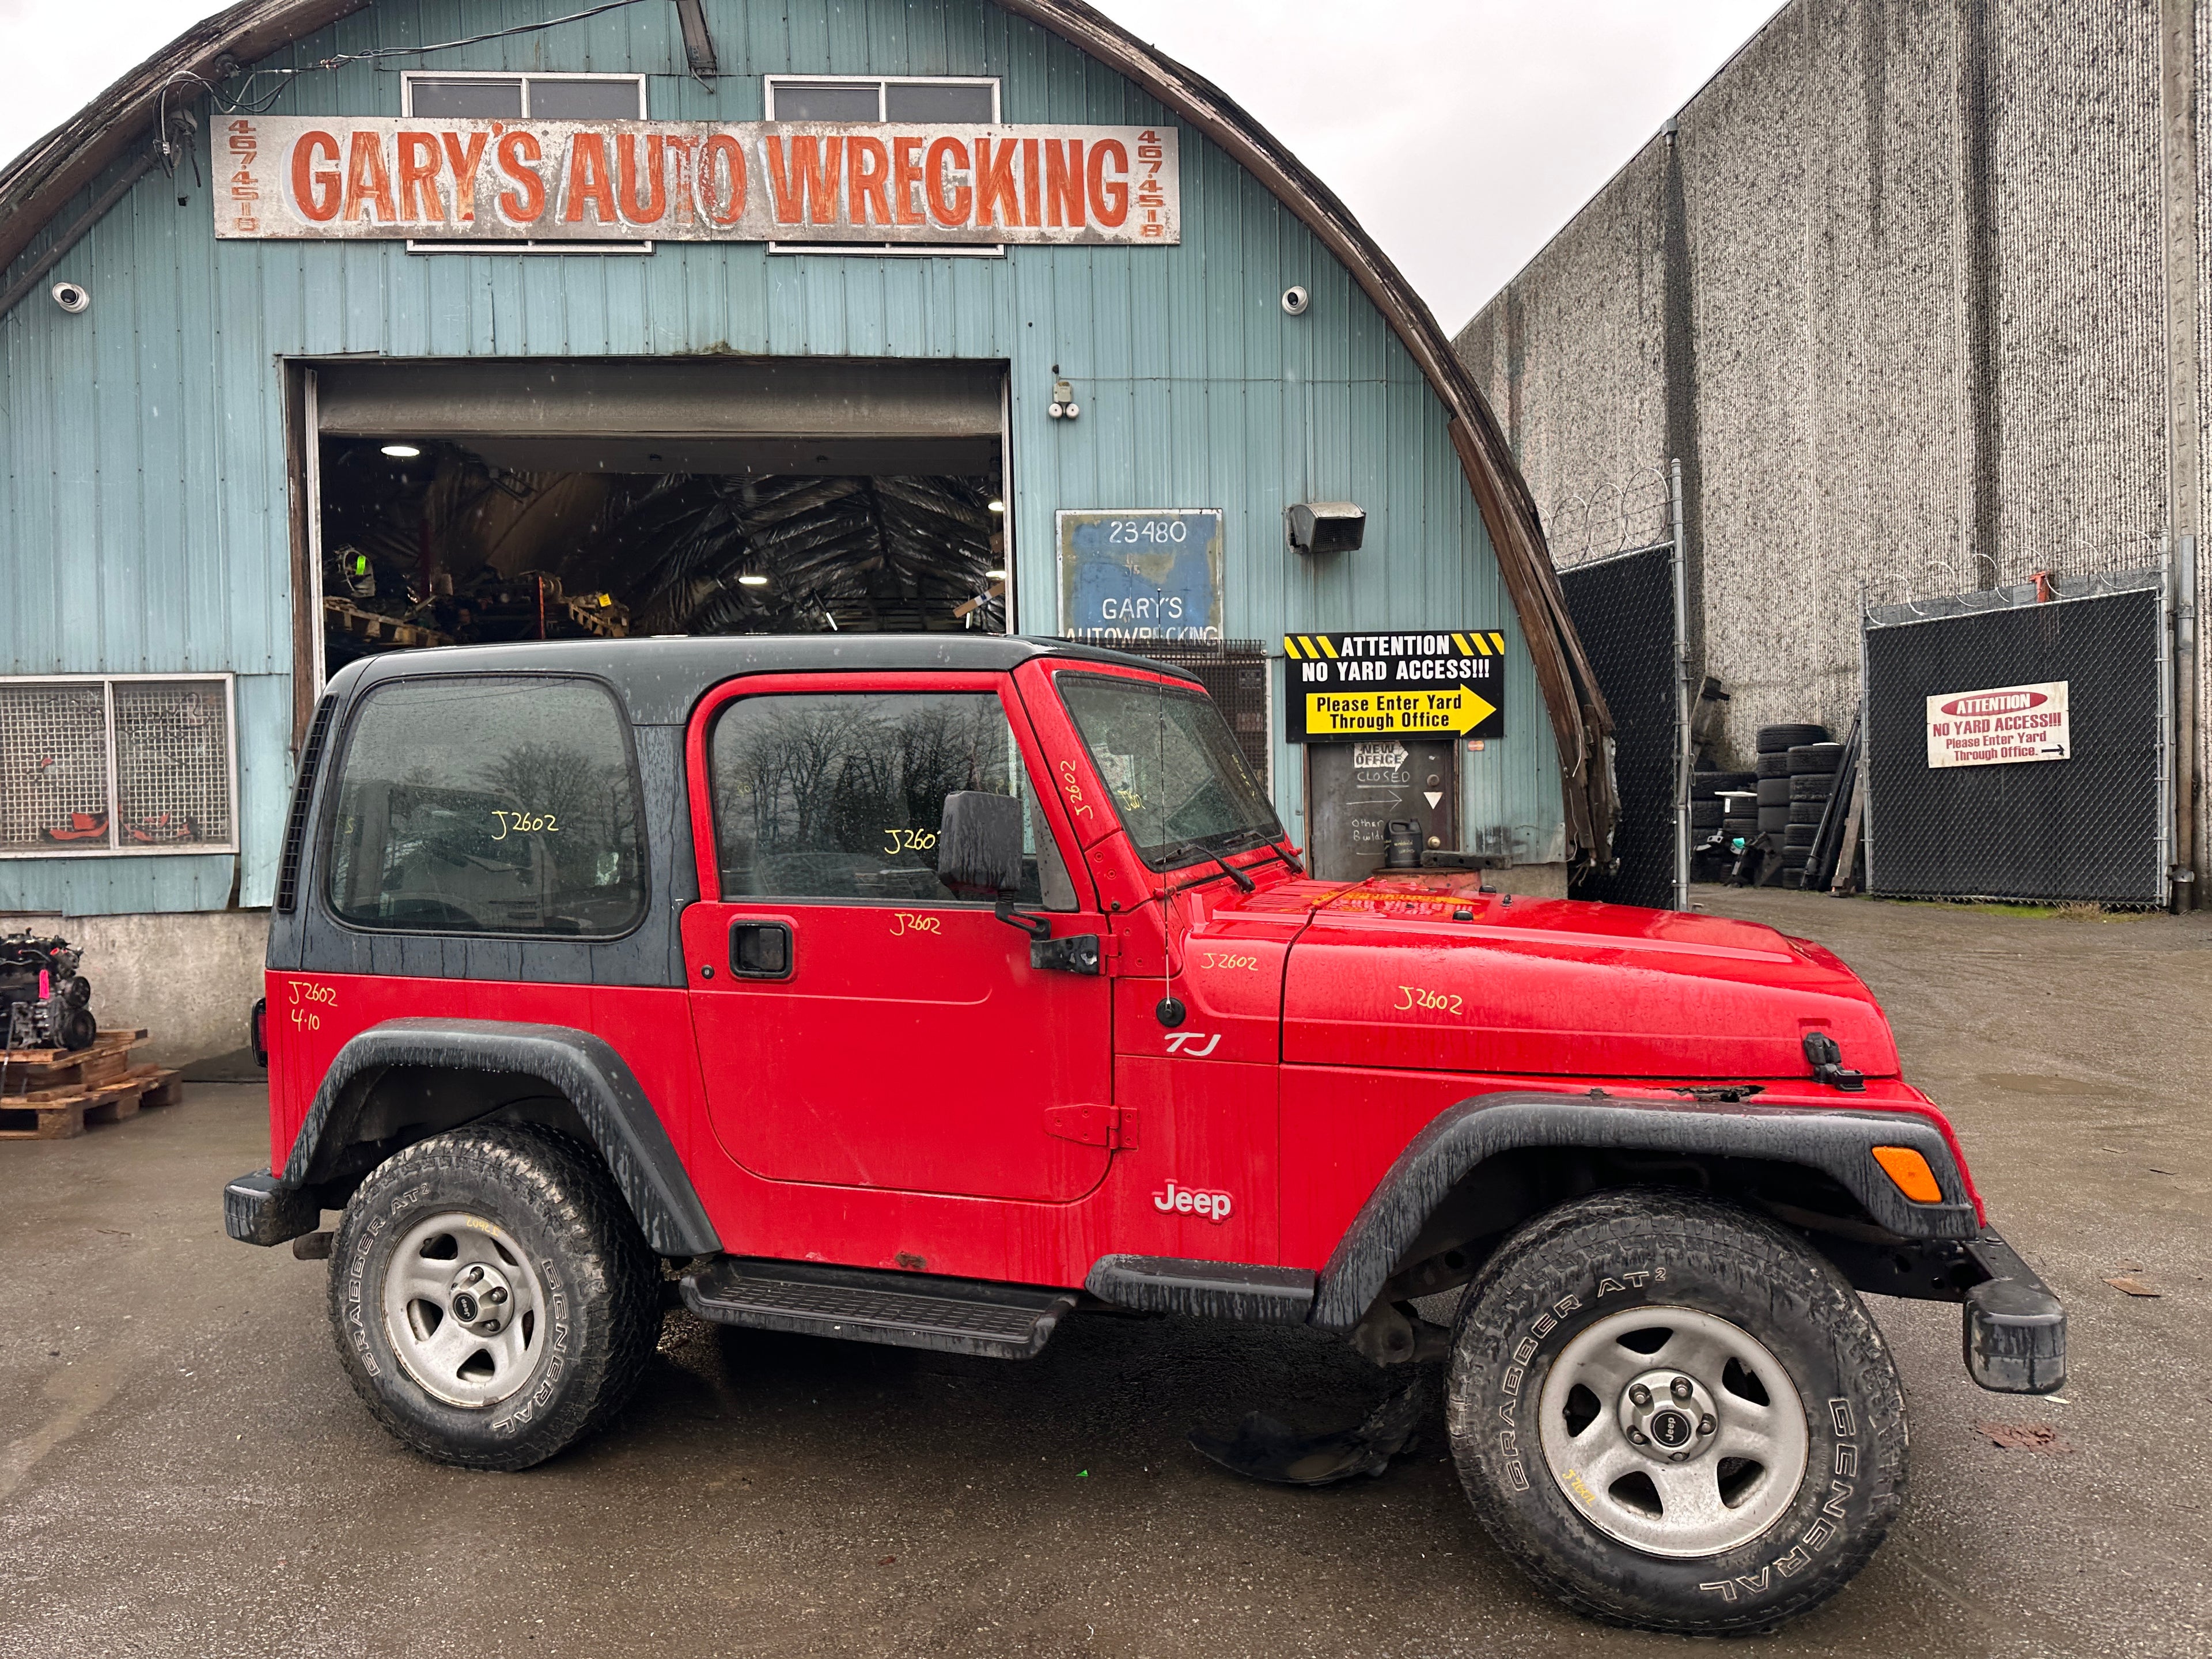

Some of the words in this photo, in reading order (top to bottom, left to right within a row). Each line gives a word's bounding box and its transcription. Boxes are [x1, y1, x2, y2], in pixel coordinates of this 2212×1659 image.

[287, 123, 546, 224] GARY'S
[565, 131, 748, 226] AUTO
[765, 135, 1130, 228] WRECKING
[1109, 521, 1187, 543] 23480
[1102, 597, 1183, 620] GARY'S
[1340, 635, 1450, 657] ATTENTION
[1302, 662, 1328, 682] NO
[1336, 661, 1387, 681] YARD
[1396, 658, 1490, 680] ACCESS!!!
[1317, 697, 1369, 712] Please
[1377, 695, 1419, 711] Enter
[1427, 694, 1462, 710] Yard
[1956, 693, 2031, 715] ATTENTION
[1330, 713, 1394, 731] Through
[1402, 712, 1449, 728] Office
[1933, 722, 1950, 737] NO
[1954, 719, 1990, 735] YARD
[1994, 712, 2062, 732] ACCESS!!!
[1361, 744, 1393, 754] NEW
[1946, 738, 1980, 749] Please
[1983, 734, 2014, 746] Enter
[2017, 730, 2047, 743] Yard
[1954, 748, 1998, 762] Through
[2001, 747, 2039, 758] Office.
[1357, 771, 1410, 783] CLOSED
[1059, 760, 1093, 820] J2602
[491, 810, 559, 840] J2602
[884, 828, 942, 854] J260
[889, 913, 942, 936] J2602
[1200, 952, 1259, 971] J2602
[288, 980, 338, 1007] J2602
[1393, 985, 1463, 1016] J2602
[1164, 1032, 1222, 1056] TJ
[1154, 1184, 1232, 1220] Jeep
[349, 1215, 386, 1377] GRABBER
[493, 1259, 568, 1434] GENERAL
[1499, 1294, 1583, 1493] GRABBER
[1665, 1417, 1676, 1441] Jeep
[1700, 1397, 1859, 1602] GENERAL
